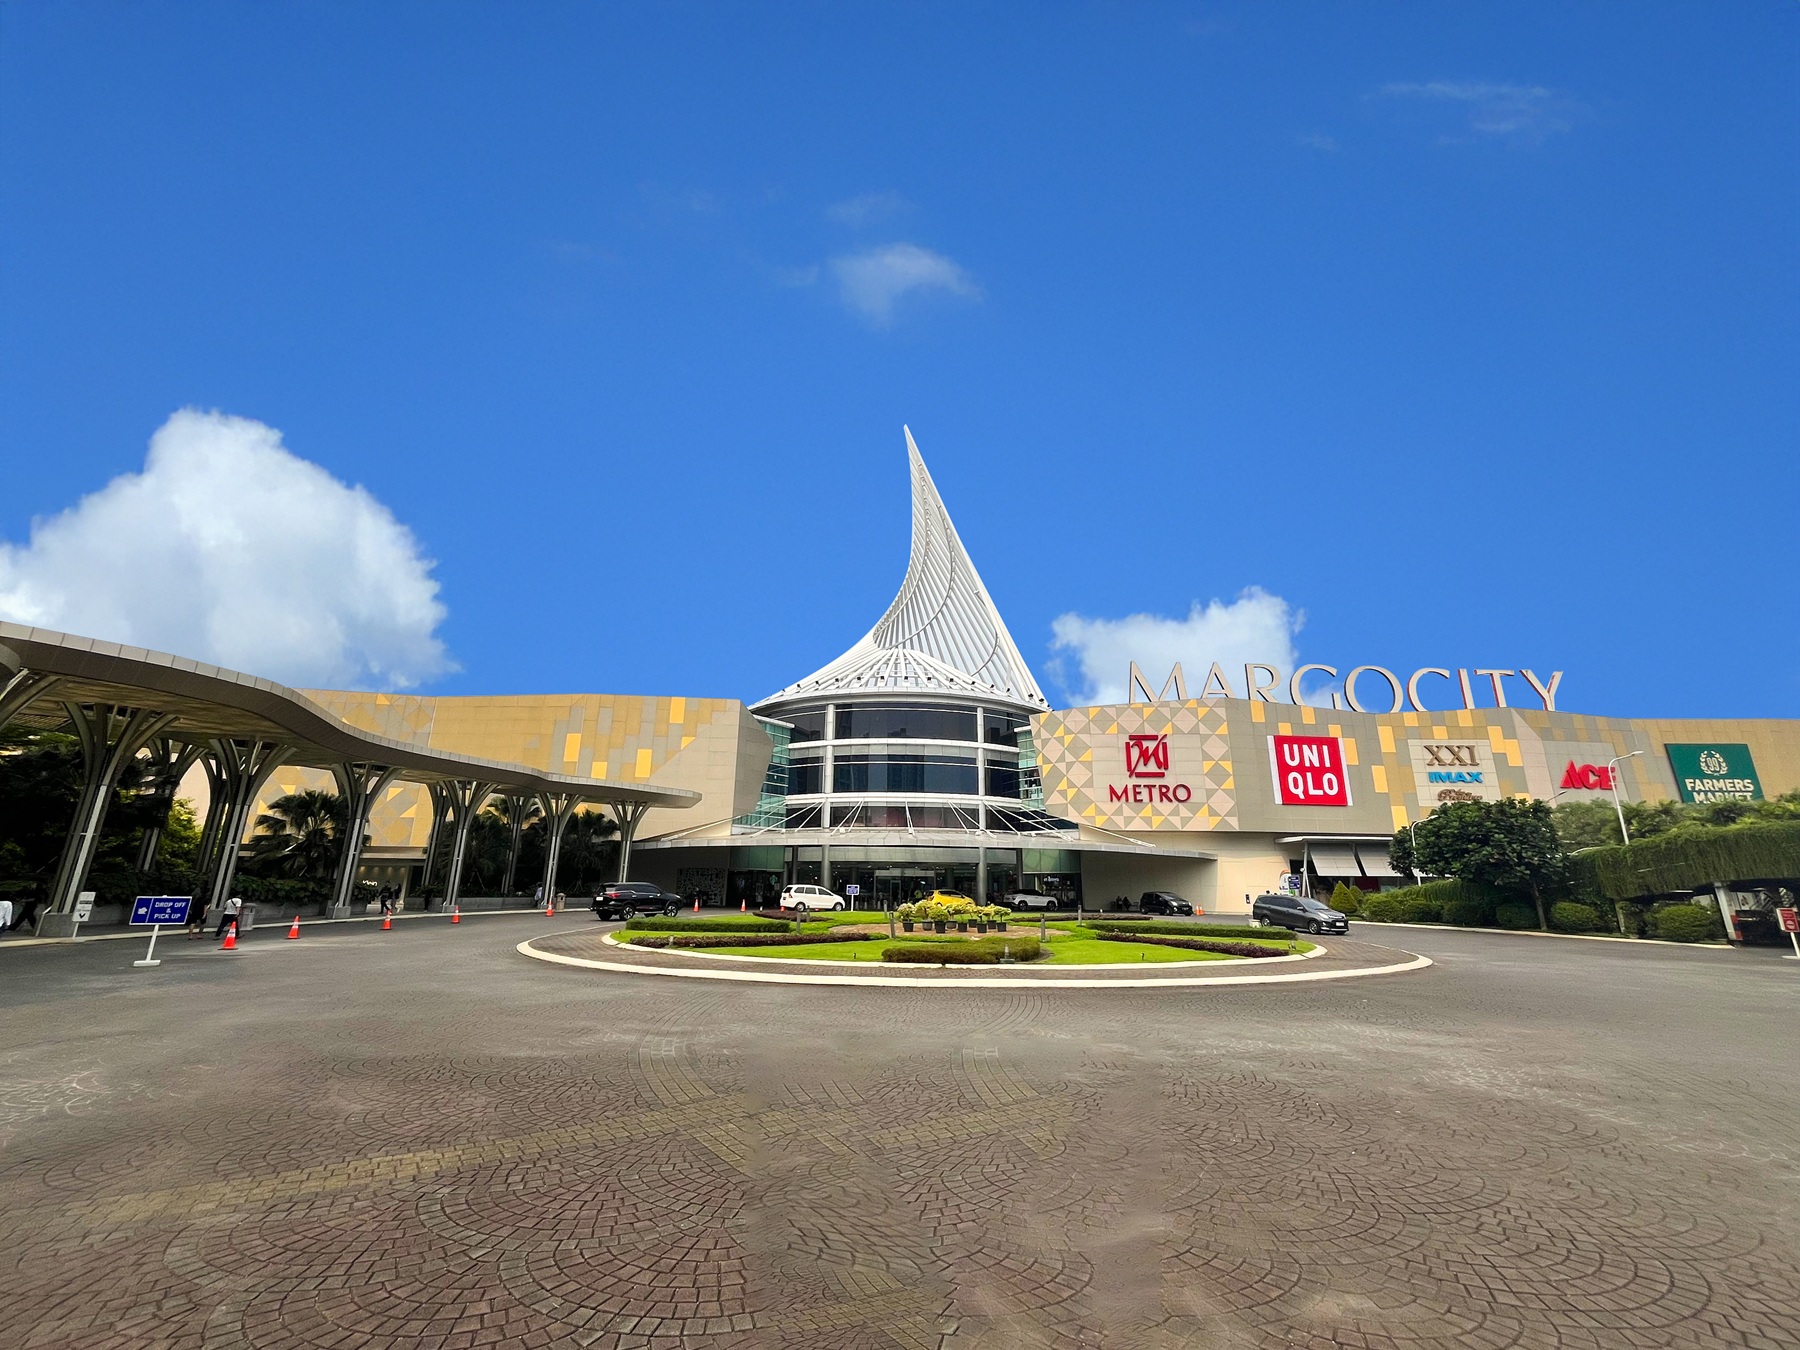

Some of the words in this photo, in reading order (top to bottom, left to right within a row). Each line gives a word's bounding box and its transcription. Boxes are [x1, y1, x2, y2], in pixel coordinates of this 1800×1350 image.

[1129, 660, 1564, 714] MARGOCITY
[1283, 743, 1331, 768] UNI
[1423, 745, 1480, 766] XXI
[1706, 757, 1720, 771] 99
[1287, 771, 1339, 800] QLO
[1428, 771, 1483, 784] IMAX
[1560, 760, 1617, 791] ACE
[1684, 778, 1755, 791] FARMERS
[1108, 783, 1192, 803] METRO
